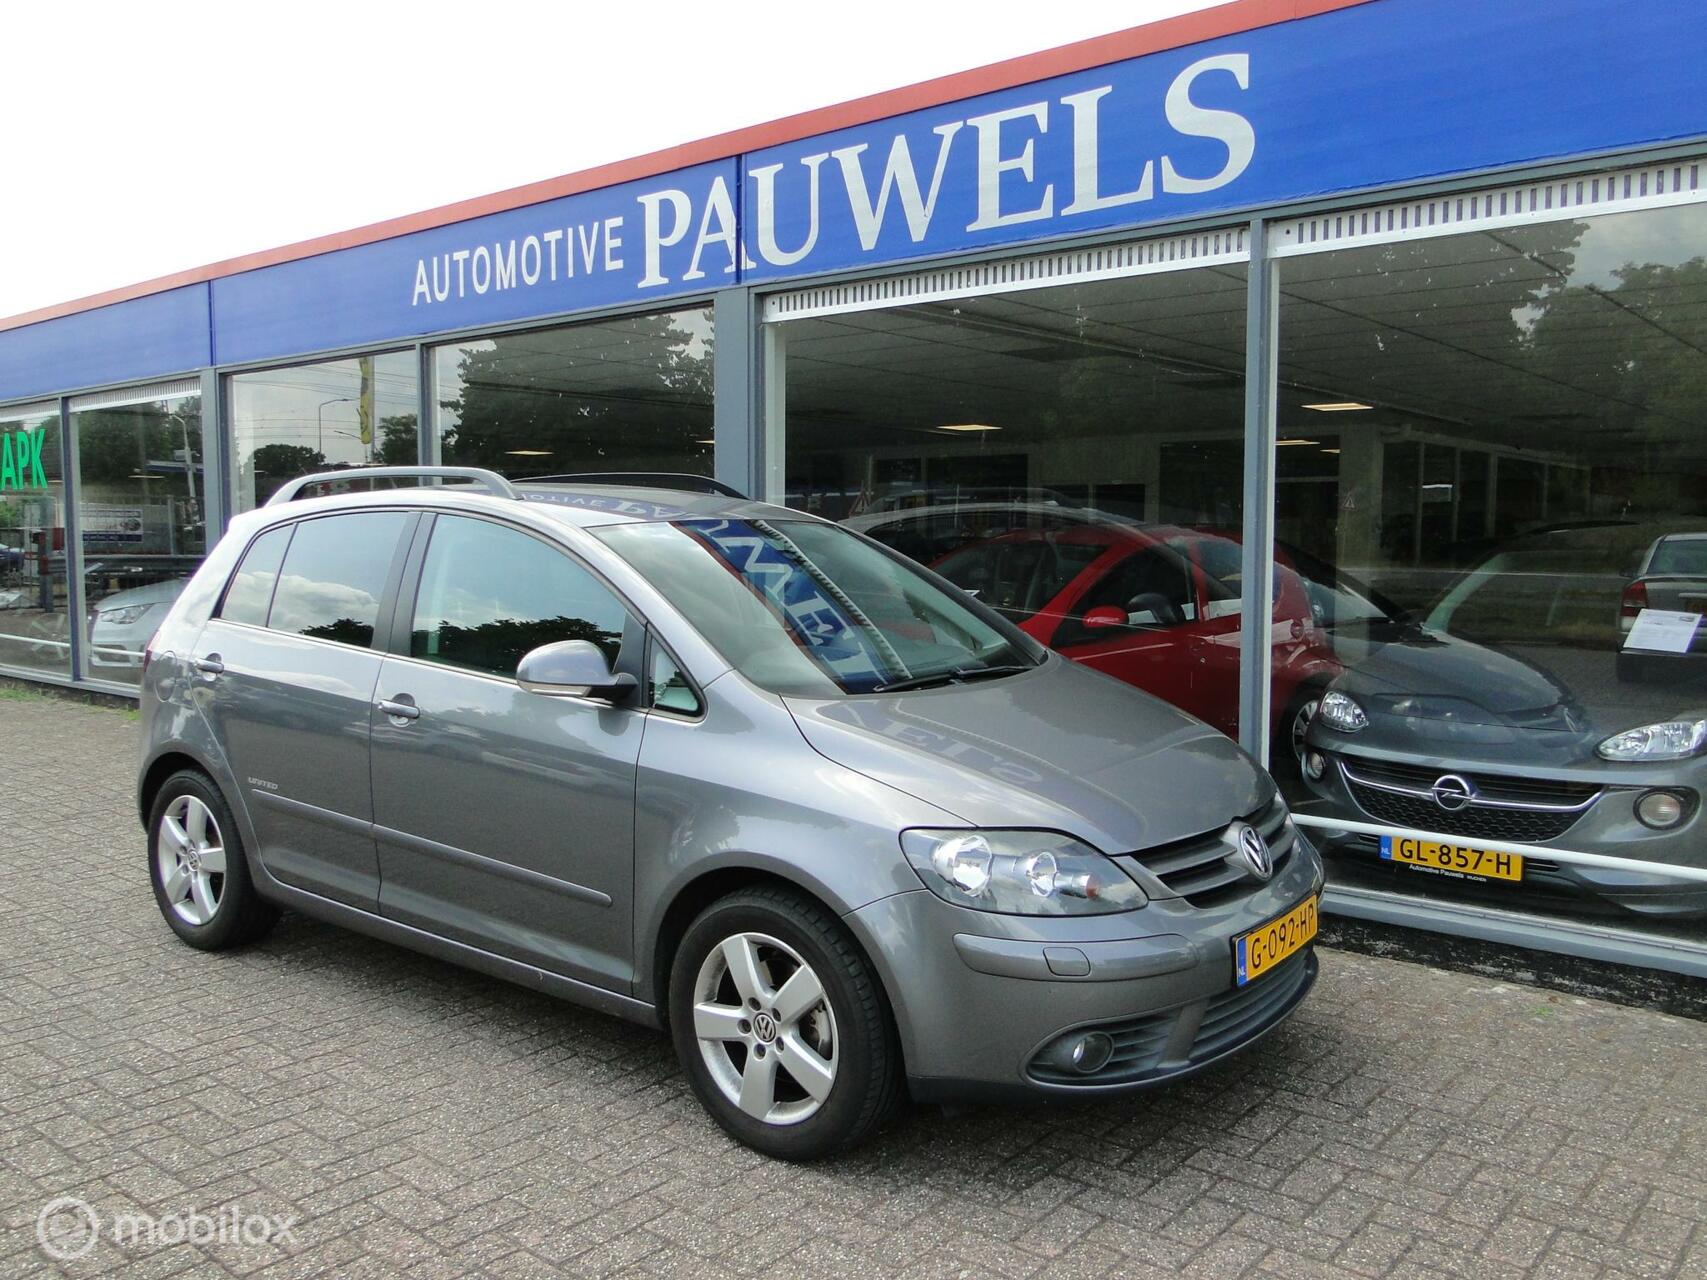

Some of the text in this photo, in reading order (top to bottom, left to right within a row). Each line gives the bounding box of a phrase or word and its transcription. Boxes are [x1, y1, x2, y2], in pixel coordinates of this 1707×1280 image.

[412, 53, 1256, 306] AUTOMOTIVE PAUWELS
[0, 428, 48, 491] APK
[1400, 838, 1512, 875] GL-857-H
[1251, 903, 1314, 969] G-092-HP
